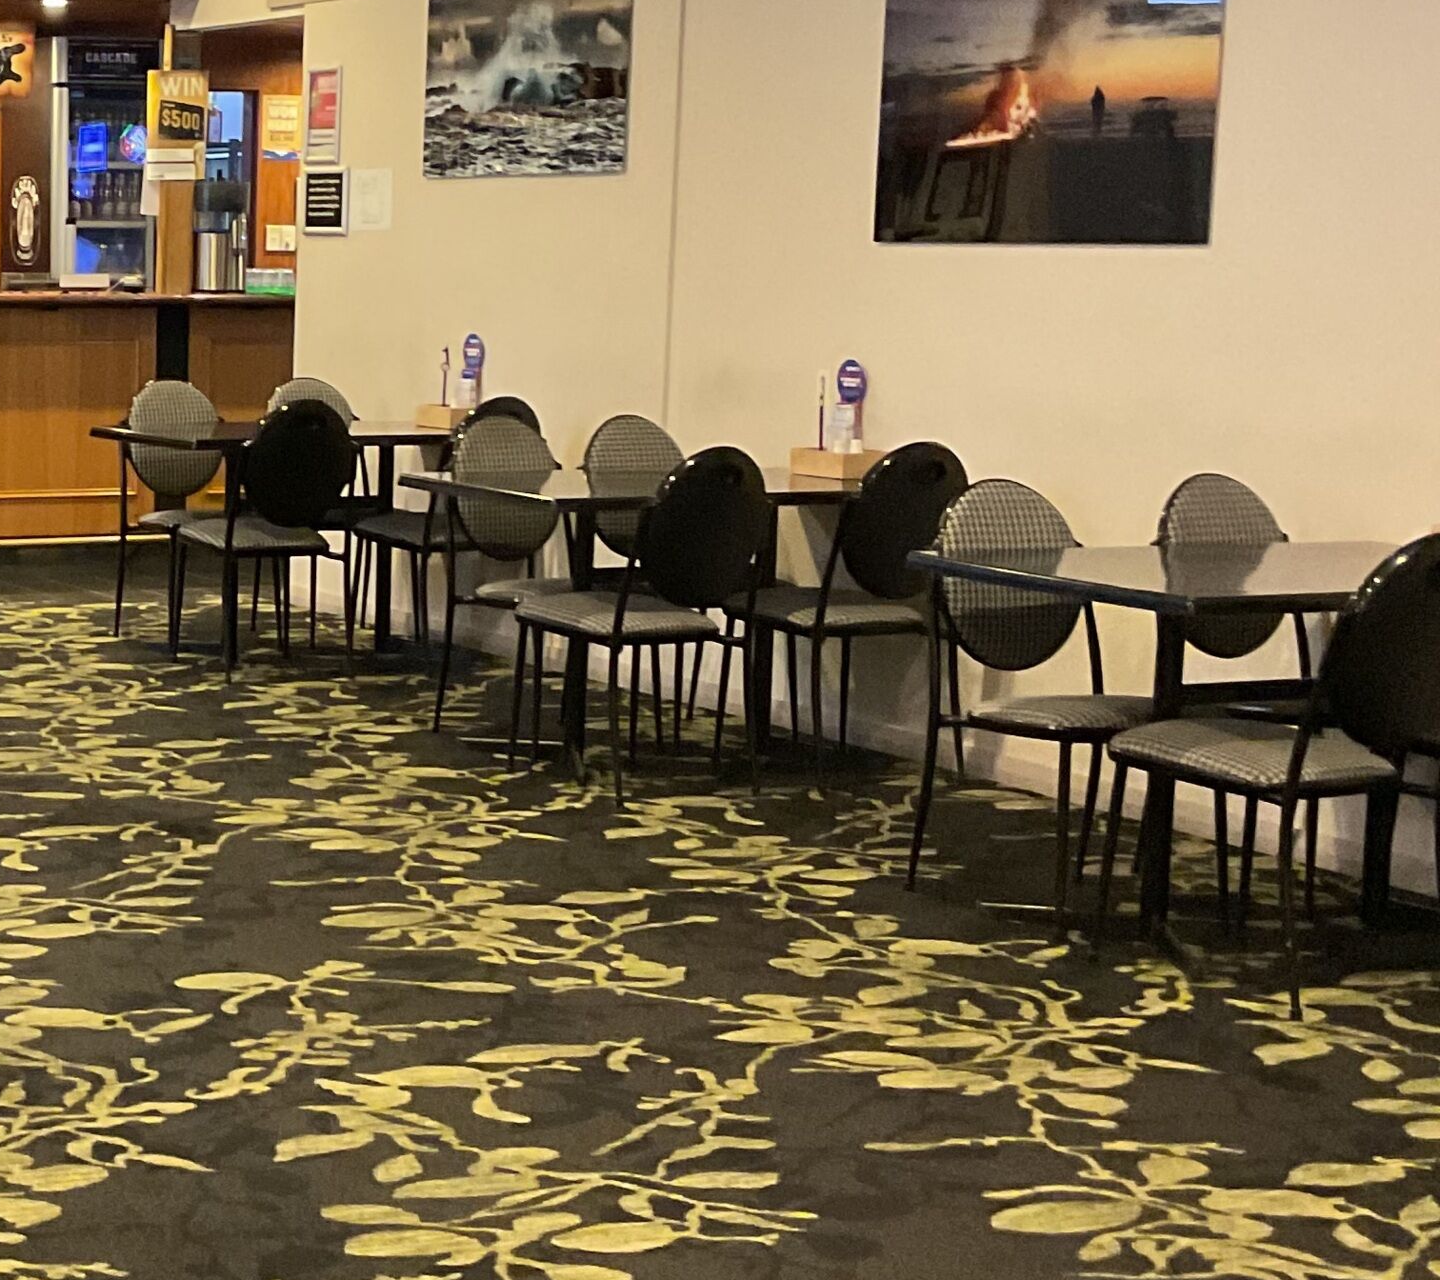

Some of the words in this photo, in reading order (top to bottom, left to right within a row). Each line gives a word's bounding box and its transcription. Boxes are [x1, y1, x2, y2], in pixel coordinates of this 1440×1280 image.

[85, 51, 138, 64] CASCADE
[161, 74, 205, 97] WIN
[161, 108, 201, 131] $500
